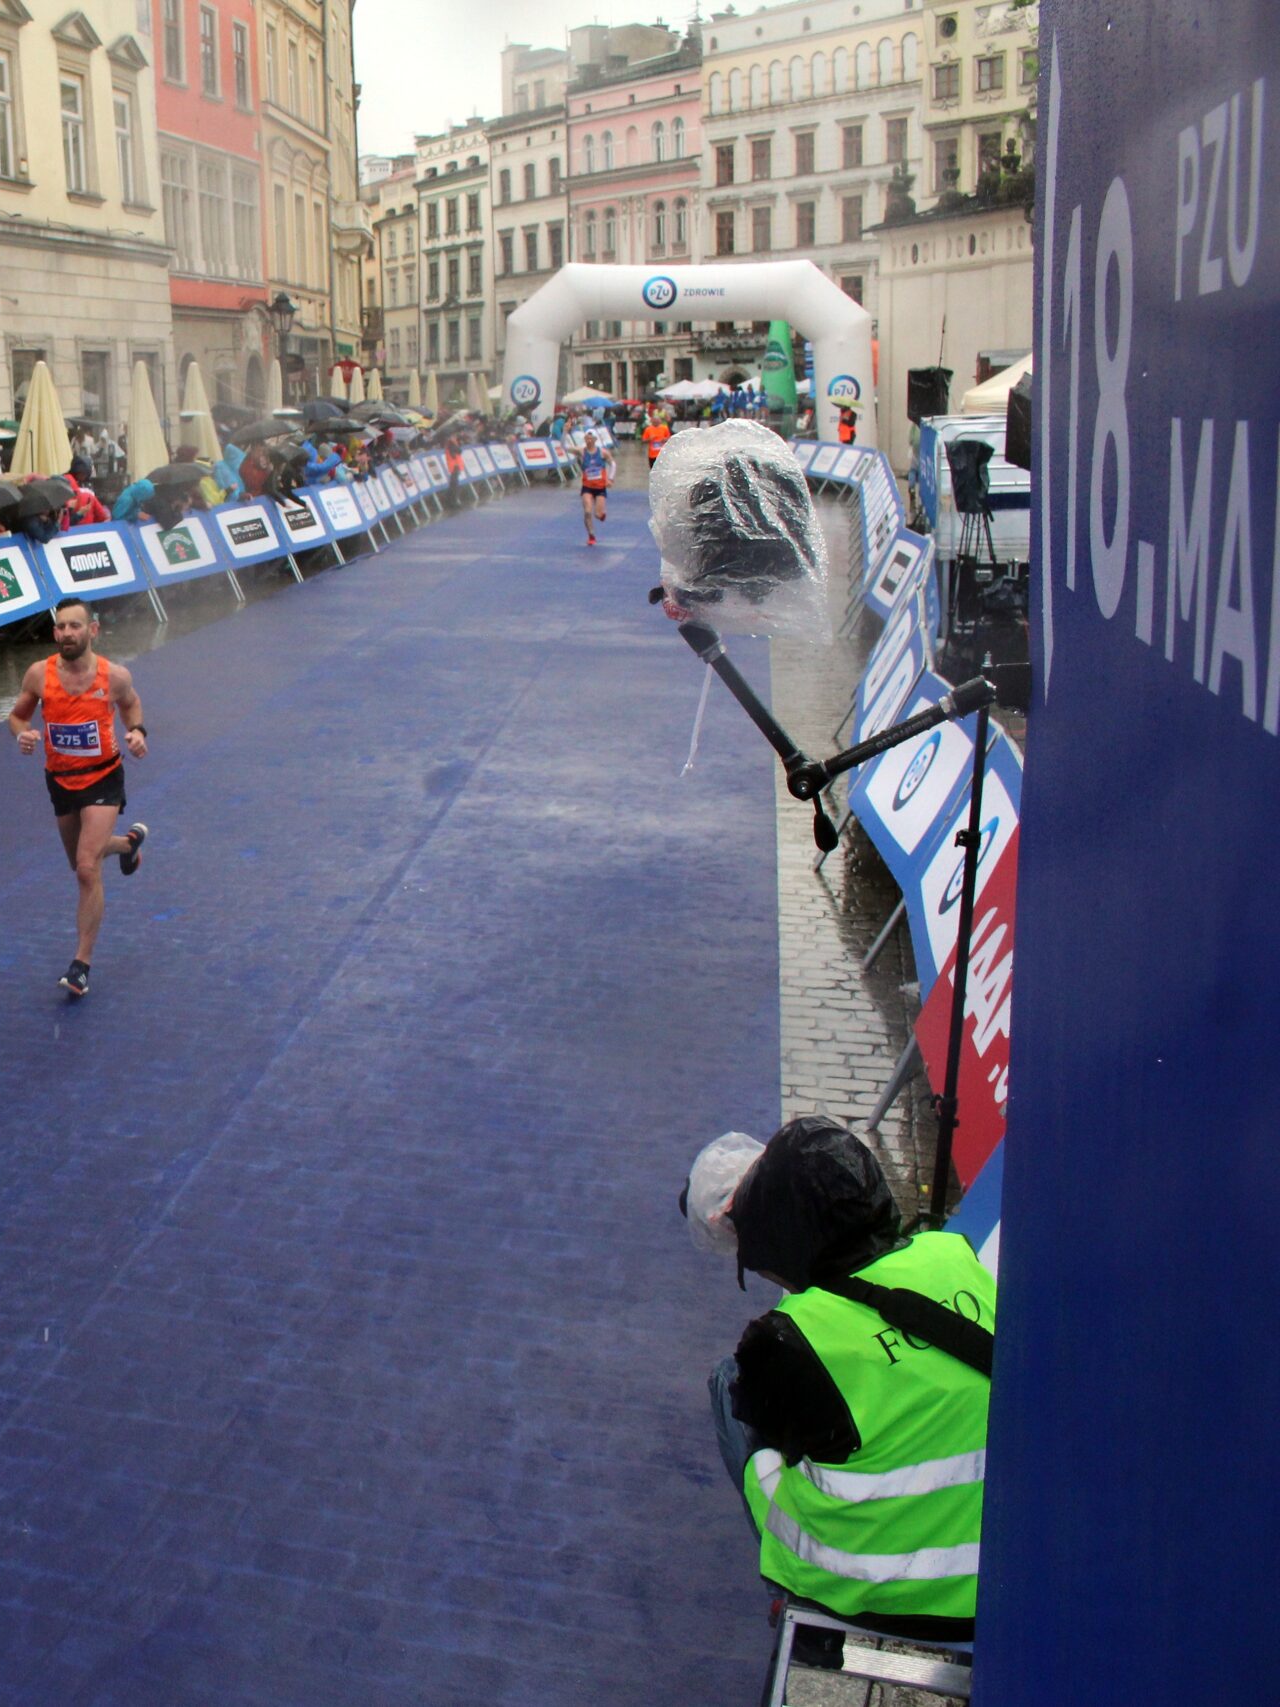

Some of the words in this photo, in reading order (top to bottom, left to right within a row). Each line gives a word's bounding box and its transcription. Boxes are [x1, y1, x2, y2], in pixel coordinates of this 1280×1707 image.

[1175, 77, 1264, 301] PZU
[650, 285, 669, 300] PZU
[683, 288, 725, 296] ZDROWIE
[70, 550, 111, 573] 4MOVE
[1165, 417, 1280, 737] MA
[56, 734, 81, 746] 275
